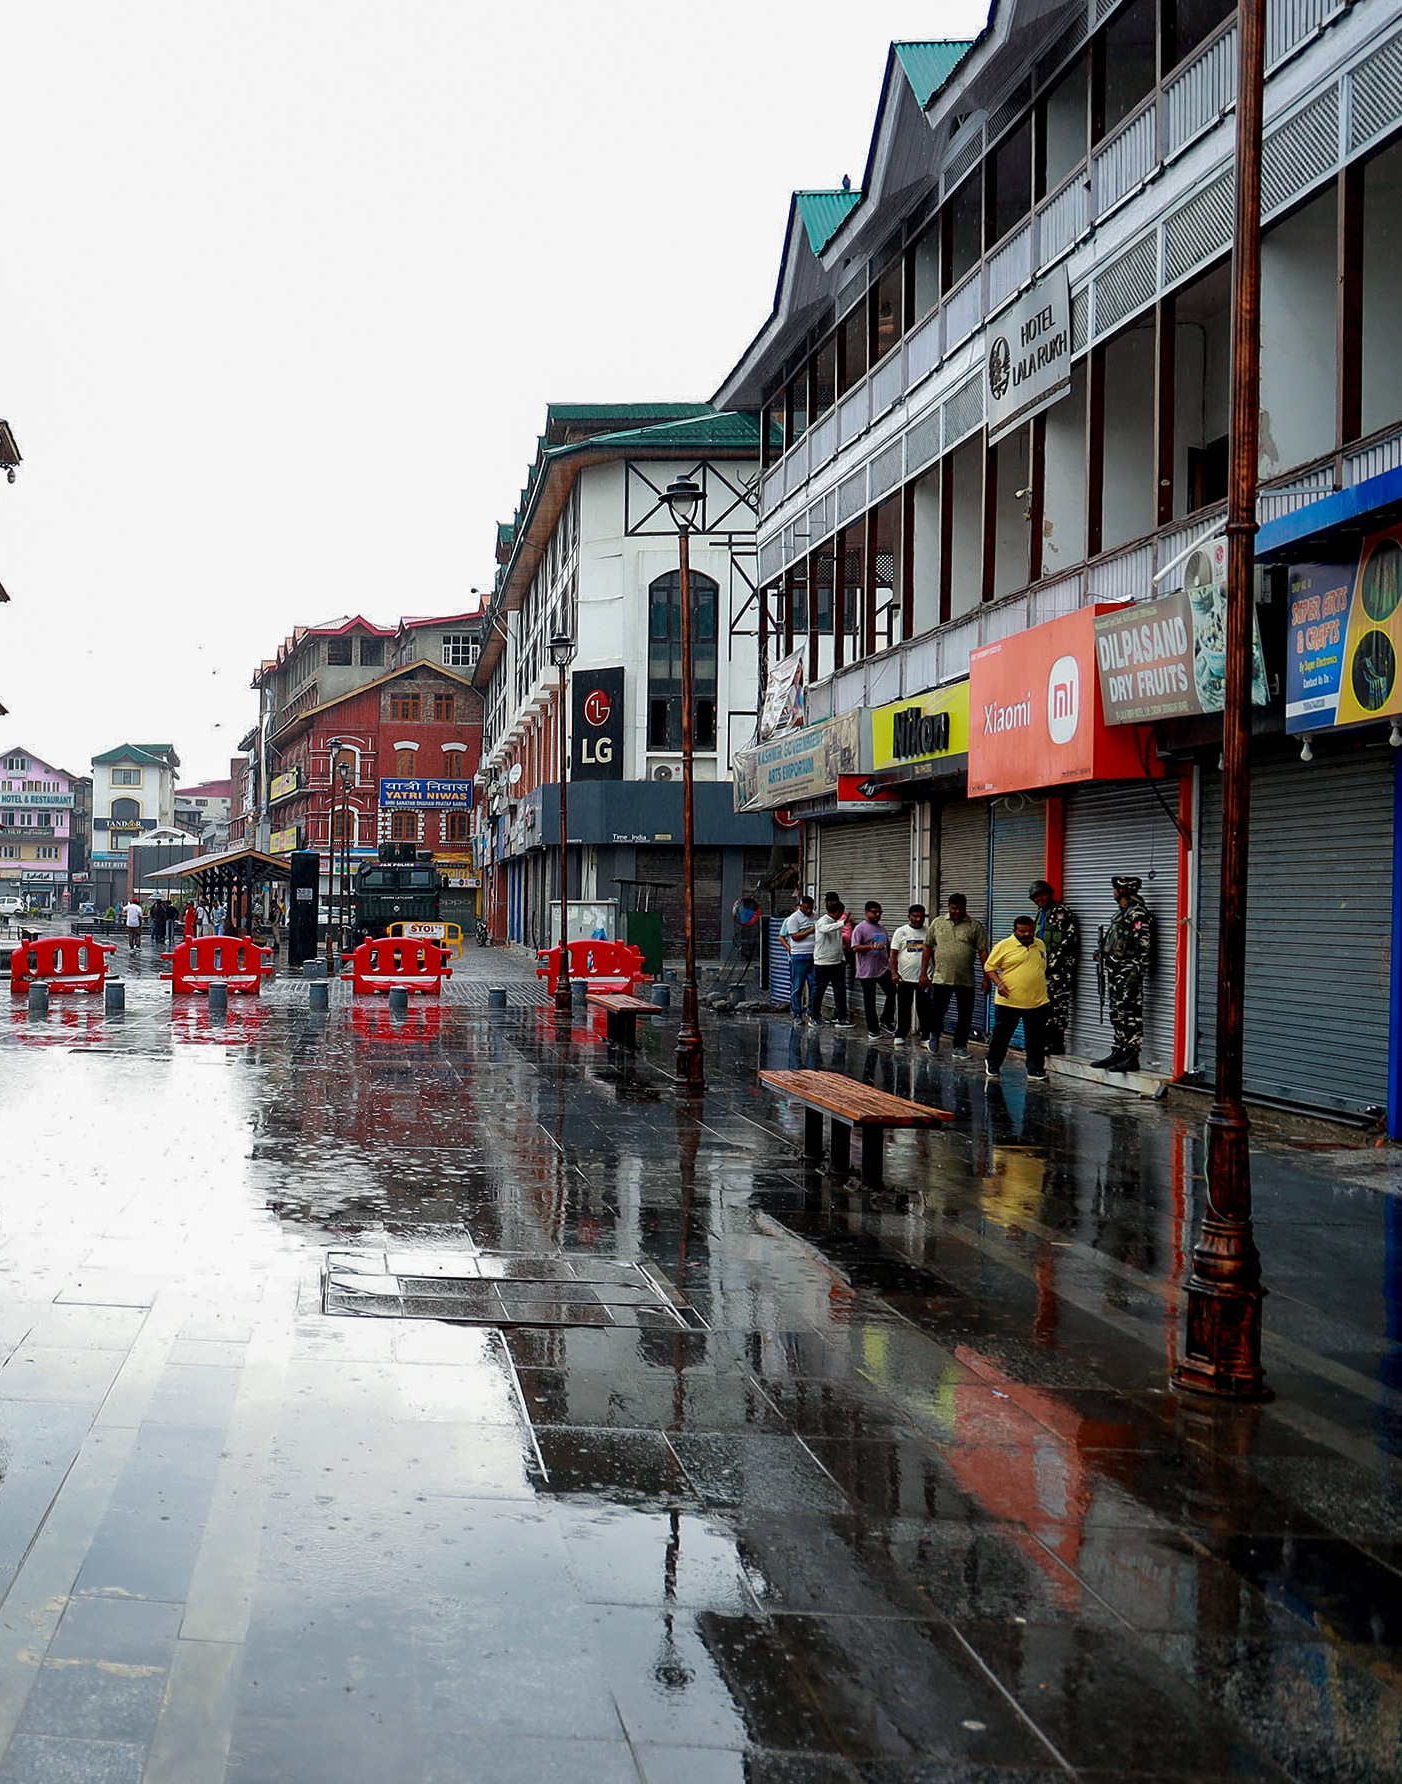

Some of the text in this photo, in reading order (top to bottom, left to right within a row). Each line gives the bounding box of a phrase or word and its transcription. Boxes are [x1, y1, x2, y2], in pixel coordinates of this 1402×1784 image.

[1021, 305, 1056, 347] HOTEL
[1038, 330, 1067, 369] RUKH
[1292, 586, 1348, 626] SUPER ARTS
[1098, 617, 1188, 671] DILPASAND
[1306, 619, 1340, 651] CRAFTS
[1109, 663, 1189, 703] DRY FRUITS
[893, 707, 950, 759] Nikon
[983, 691, 1031, 736] Xiaomi
[581, 737, 613, 764] LG
[383, 781, 469, 791] यात्री निवास
[768, 756, 815, 786] ARTS EMPORIUM
[2, 794, 22, 804] HOTEL
[24, 795, 29, 804] &
[31, 795, 72, 805] RESTAURANT
[385, 791, 467, 800] YATRI NIWAS
